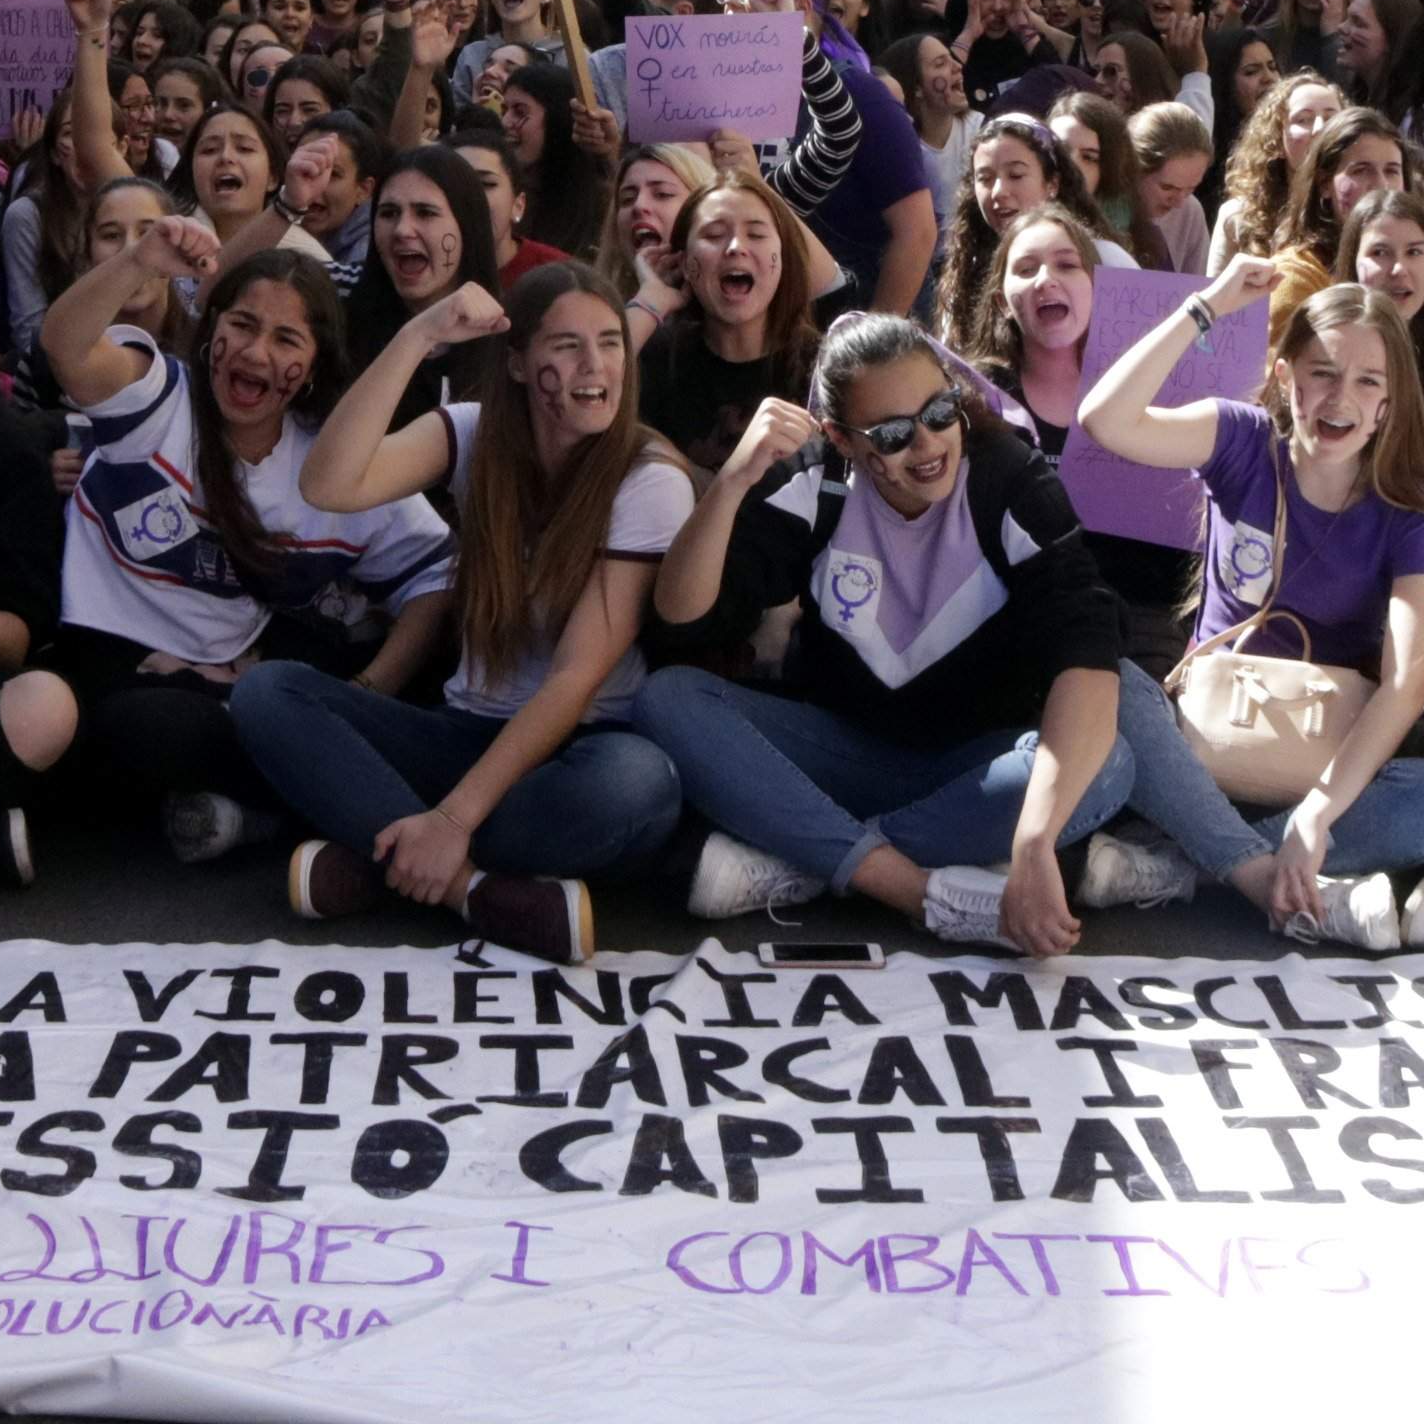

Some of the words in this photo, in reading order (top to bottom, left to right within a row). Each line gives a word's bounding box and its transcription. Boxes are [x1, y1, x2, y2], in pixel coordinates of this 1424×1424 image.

[31, 9, 40, 36] A
[635, 24, 685, 50] VOX
[671, 67, 697, 79] en
[712, 60, 783, 77] nuestras
[655, 96, 778, 122] trincheras
[122, 939, 882, 1028] VIOLÈNCIA
[88, 1023, 1032, 1110] PATRIARCAL
[1057, 1037, 1130, 1106] I
[490, 1219, 563, 1288] I
[665, 1229, 1371, 1298] COMBATIVES
